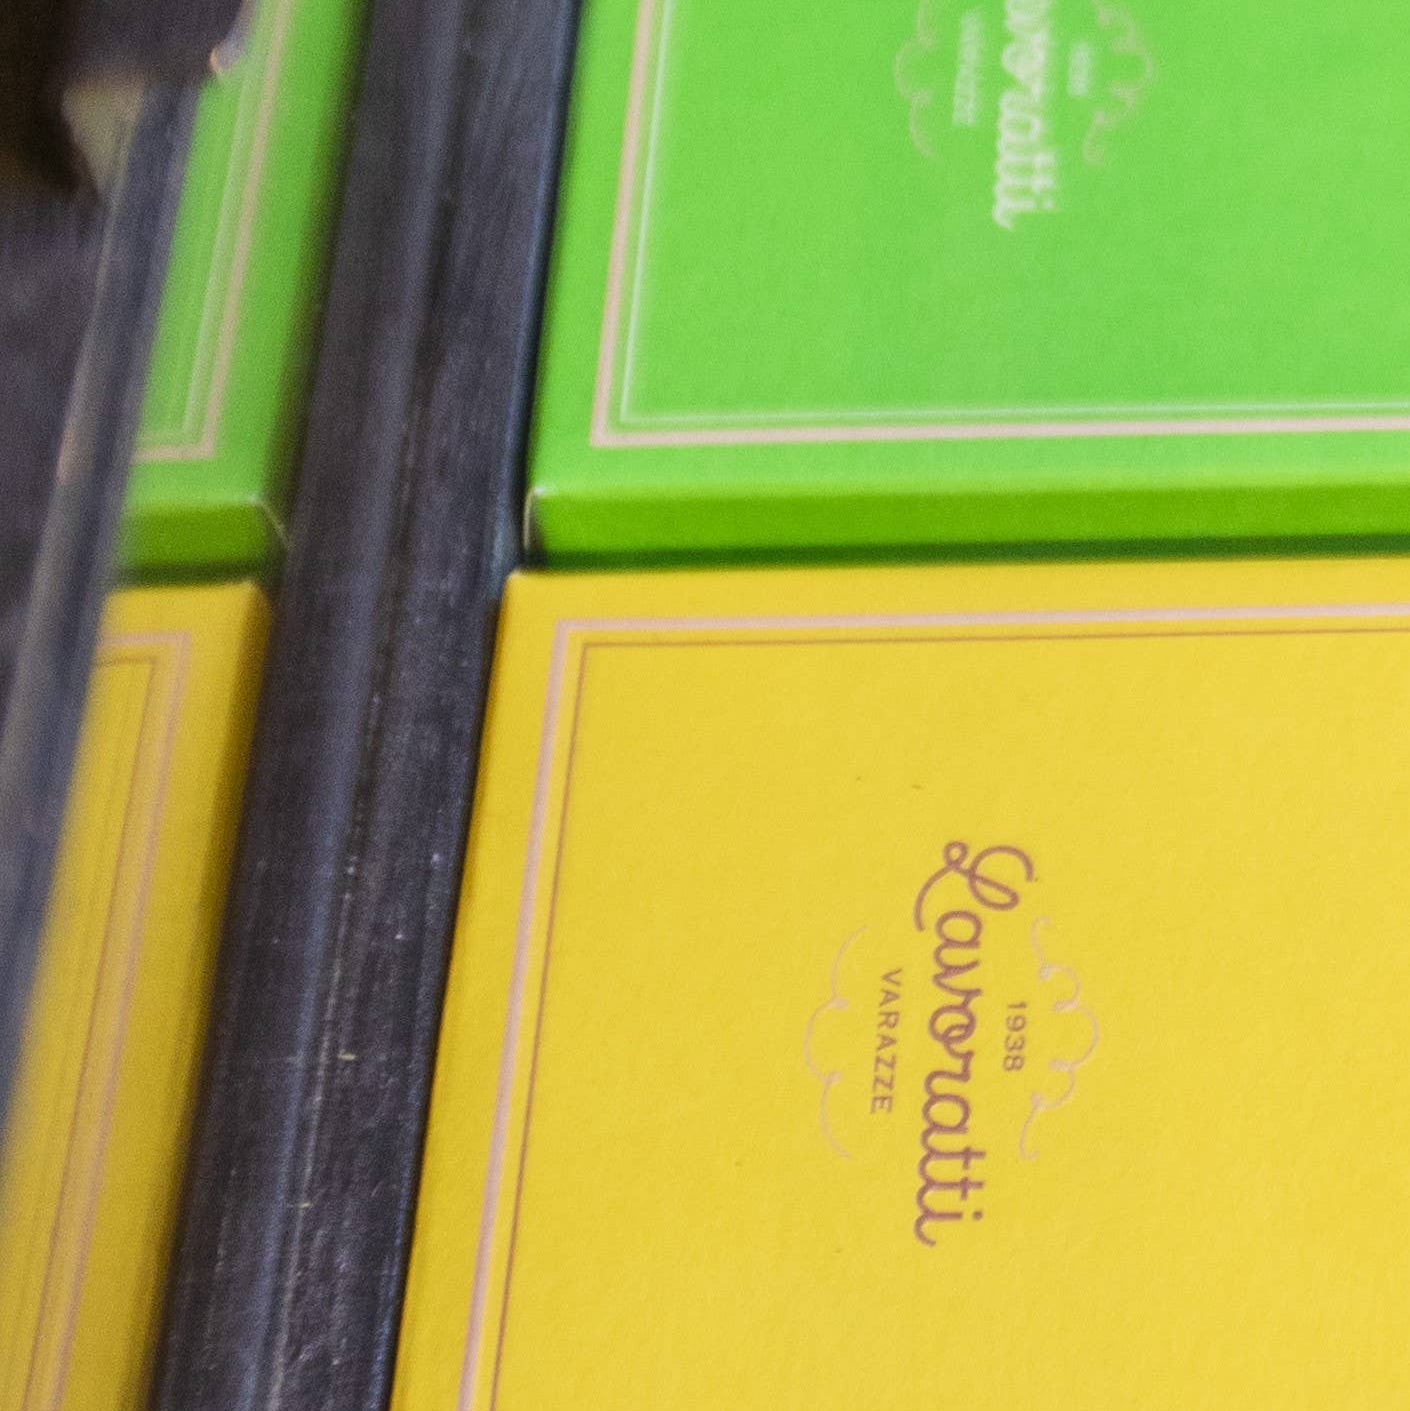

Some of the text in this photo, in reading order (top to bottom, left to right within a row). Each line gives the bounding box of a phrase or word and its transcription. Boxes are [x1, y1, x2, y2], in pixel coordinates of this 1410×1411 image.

[869, 967, 903, 1115] VARAZZE
[913, 840, 1035, 1248] Lavoratti
[1002, 1001, 1028, 1072] 1938
